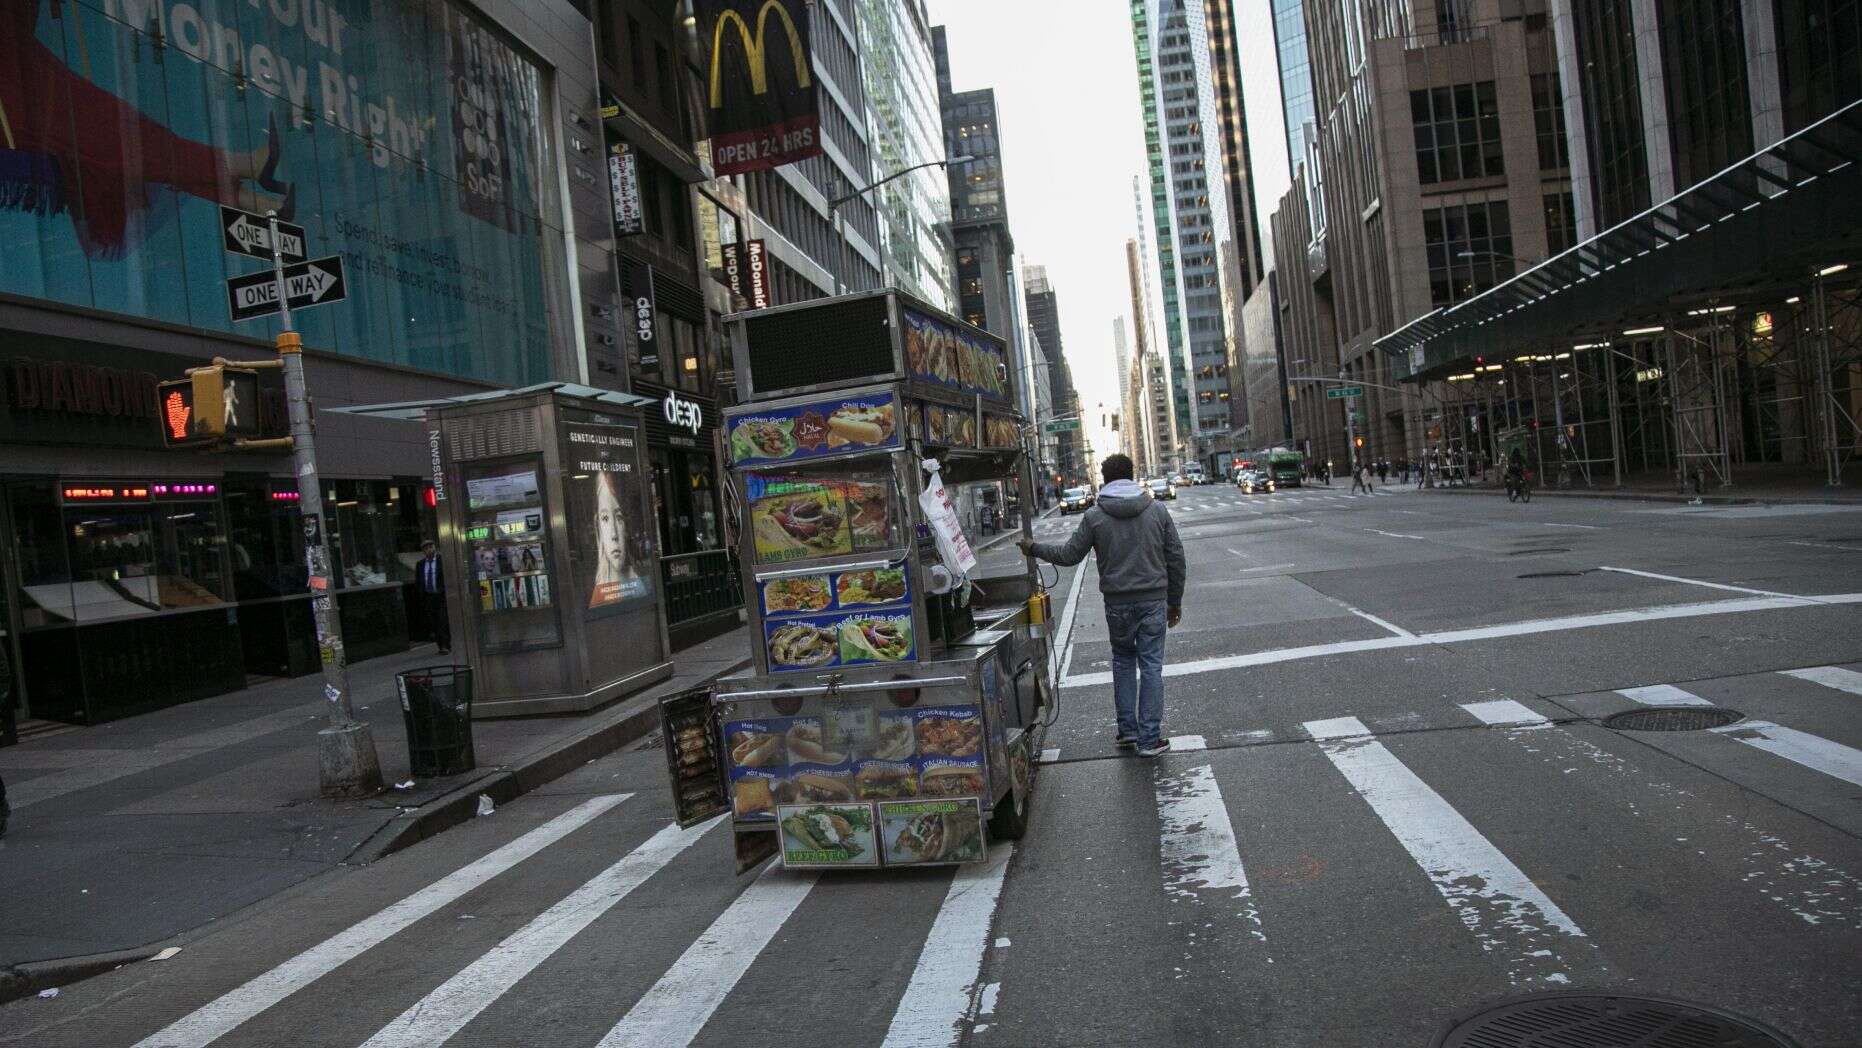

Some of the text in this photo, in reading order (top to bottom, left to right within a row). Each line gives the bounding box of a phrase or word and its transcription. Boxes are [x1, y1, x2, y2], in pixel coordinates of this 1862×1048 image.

[252, 0, 346, 55] our
[718, 127, 814, 165] OPEN 24 HRS
[237, 223, 297, 254] ONE AY
[245, 272, 325, 305] ONE WAY
[663, 390, 703, 436] deep
[737, 417, 769, 425] Chicken
[429, 429, 448, 501] Newsstand
[579, 460, 602, 472] FUTURE
[864, 613, 886, 621] Lamb
[887, 614, 906, 622] Gyro
[918, 709, 948, 718] Chicken
